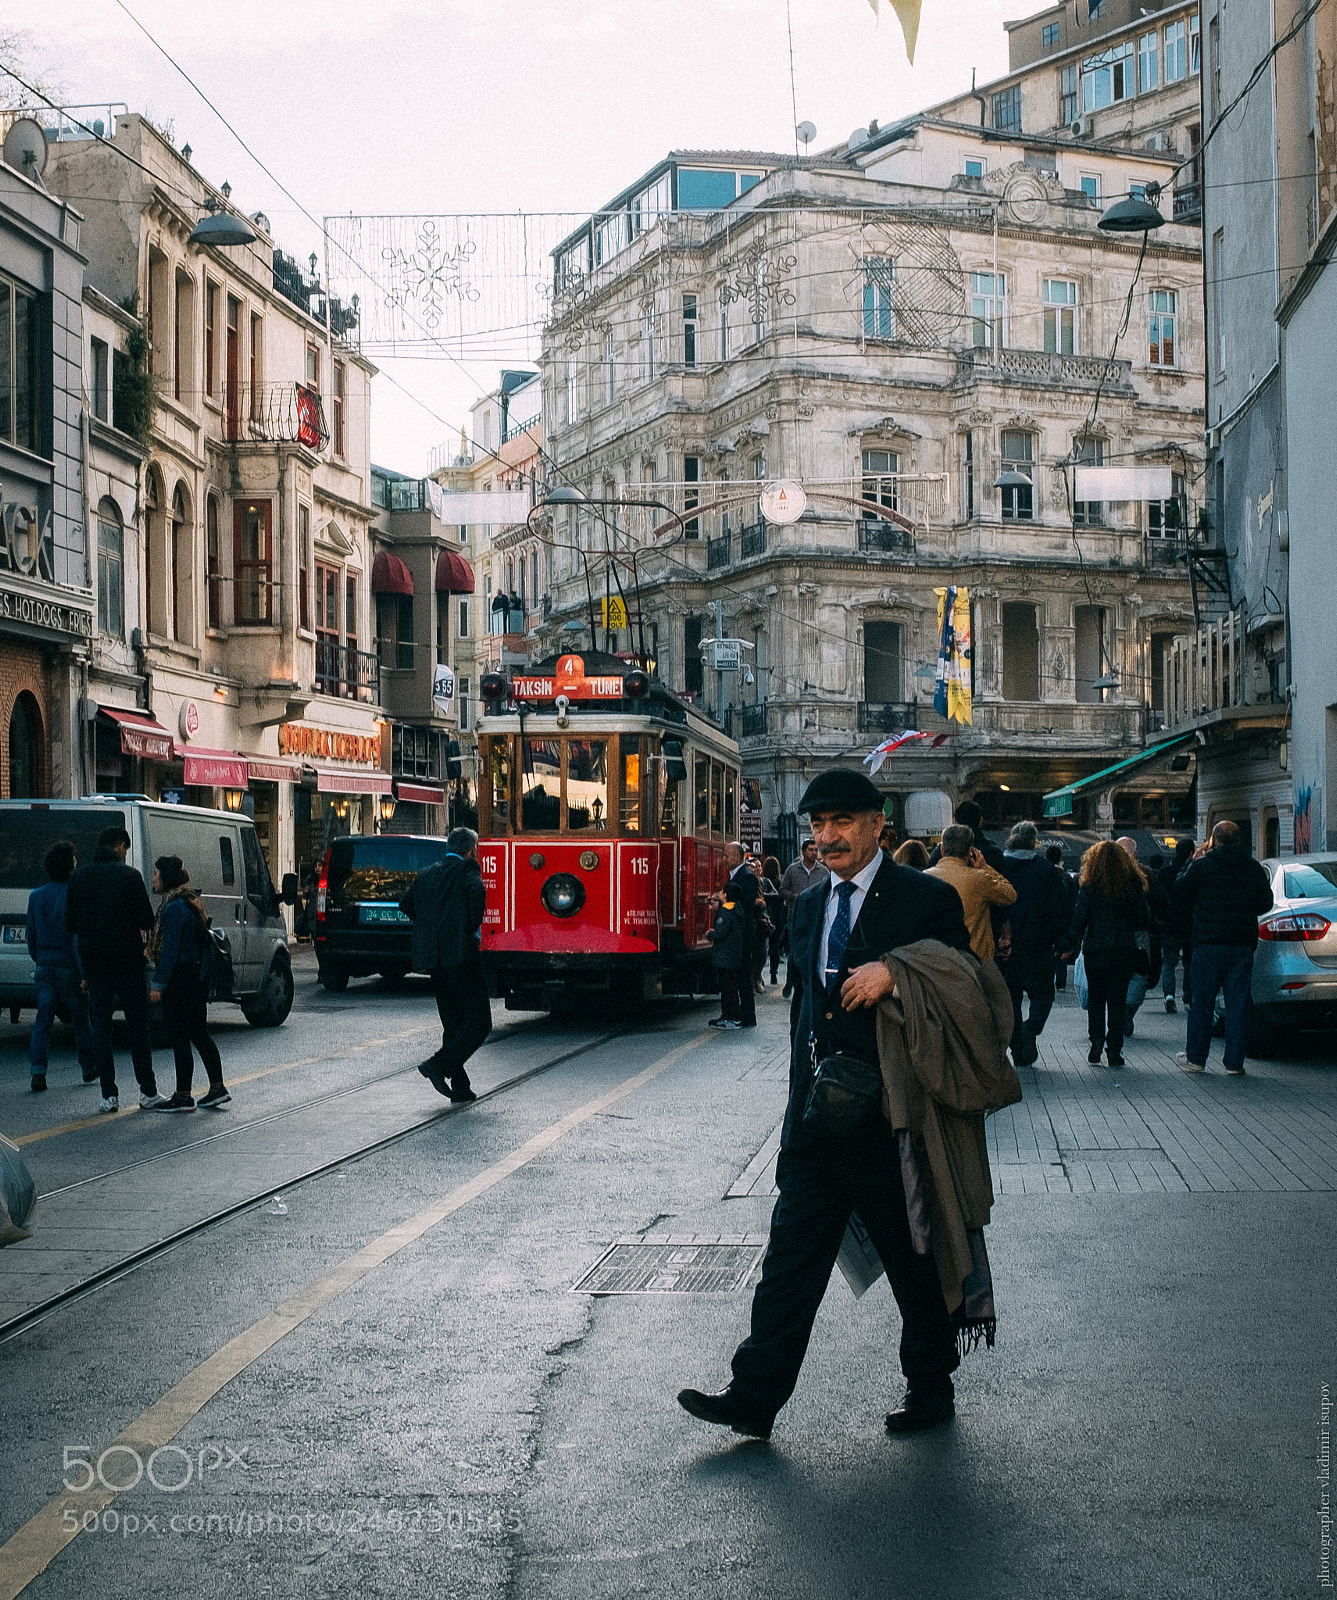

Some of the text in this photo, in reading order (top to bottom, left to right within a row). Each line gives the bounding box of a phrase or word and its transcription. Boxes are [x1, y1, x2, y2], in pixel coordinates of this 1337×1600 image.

[15, 595, 62, 629] HOTDOGS
[69, 610, 92, 636] FRIES
[564, 658, 573, 676] 4
[482, 856, 497, 873] 115
[630, 857, 649, 875] 115
